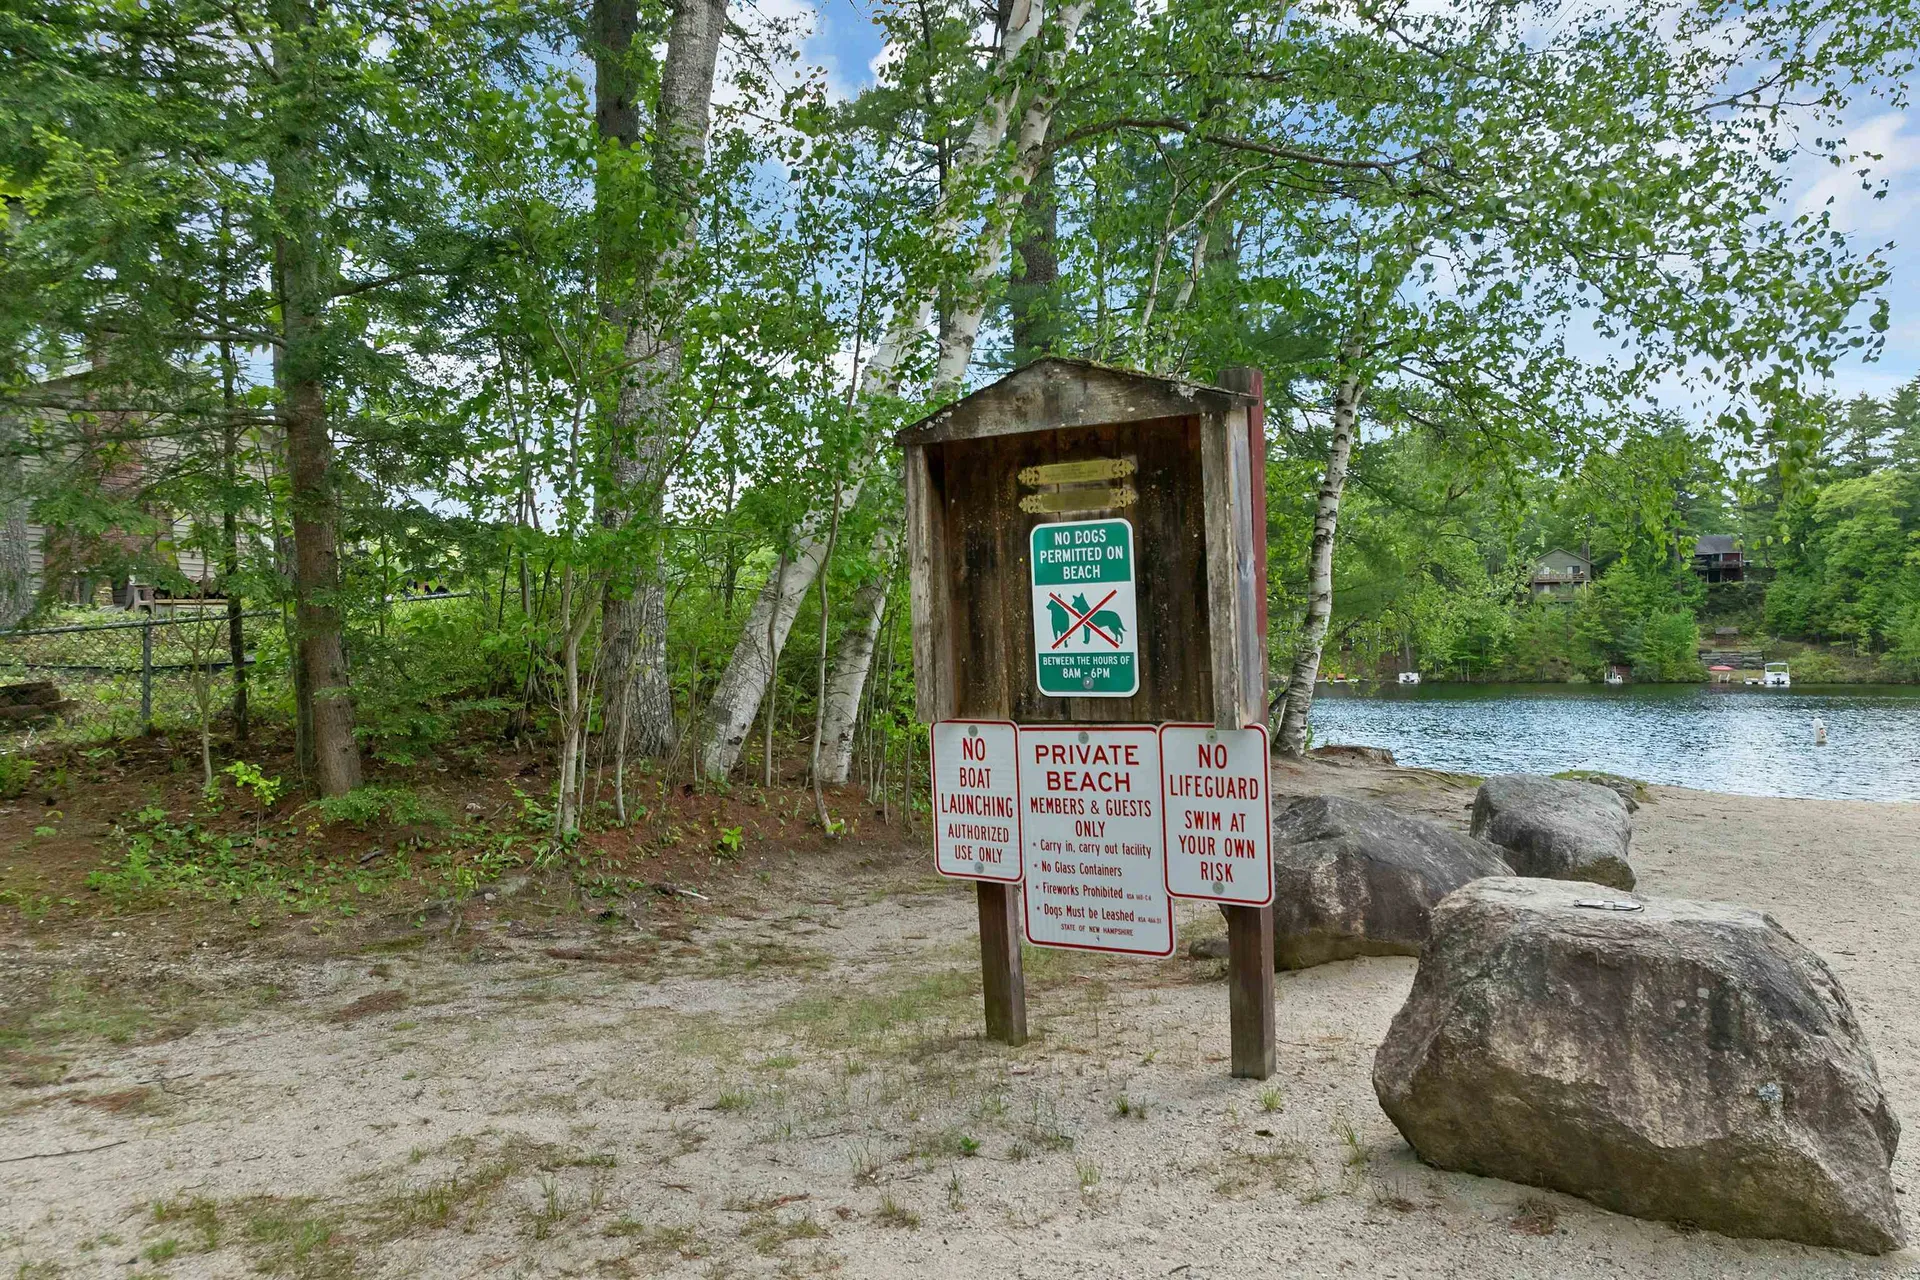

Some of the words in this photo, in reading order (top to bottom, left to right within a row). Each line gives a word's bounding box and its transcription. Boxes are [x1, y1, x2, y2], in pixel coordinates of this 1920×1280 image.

[1054, 531, 1070, 546] NO
[1075, 529, 1106, 544] DOGS
[1040, 547, 1102, 564] PERMITTED
[1106, 546, 1123, 560] ON
[1063, 565, 1101, 580] BEACH
[1042, 656, 1075, 666] BETWEEN
[1076, 656, 1091, 665] THE
[1092, 656, 1118, 665] HOURS
[1119, 656, 1131, 665] OF
[1062, 668, 1081, 678] 8AM
[1090, 668, 1110, 678] 6PM
[962, 737, 986, 761] NO
[1035, 745, 1140, 766] PRIVATE
[1198, 744, 1227, 769] NO
[959, 767, 991, 789] BOAT
[1046, 771, 1131, 793] BEACH
[1169, 774, 1259, 800] LIFEGUARD
[941, 793, 1013, 818] LAUNCHING
[1030, 797, 1085, 815] MEMBERS
[1090, 800, 1100, 815] &
[1105, 800, 1152, 817] GUESTS
[1075, 820, 1106, 838] ONLY
[1184, 810, 1221, 831] SWIM
[1230, 812, 1246, 832] AT
[948, 823, 1009, 843] AUTHORIZED
[955, 845, 973, 861] USE
[979, 847, 1003, 864] ONLY
[1040, 839, 1062, 854] Carry
[1078, 843, 1100, 856] carry
[1104, 843, 1118, 855] out
[1122, 843, 1152, 859] facility
[1178, 834, 1216, 856] YOUR
[1224, 838, 1256, 859] OWN
[1041, 860, 1052, 873] No
[1054, 861, 1076, 874] Glass
[1079, 862, 1123, 877] Containers
[1200, 861, 1234, 883] RISK
[1042, 882, 1080, 896] Fireworks
[1082, 885, 1123, 899] Prohibited
[1044, 904, 1063, 919] Dogs
[1066, 905, 1085, 918] Must
[1088, 907, 1098, 919] be
[1101, 907, 1134, 922] Leashed
[1060, 923, 1076, 932] STATE
[1078, 924, 1086, 932] OF
[1088, 925, 1100, 933] NEW
[1102, 926, 1134, 936] HAMPSHIRE
